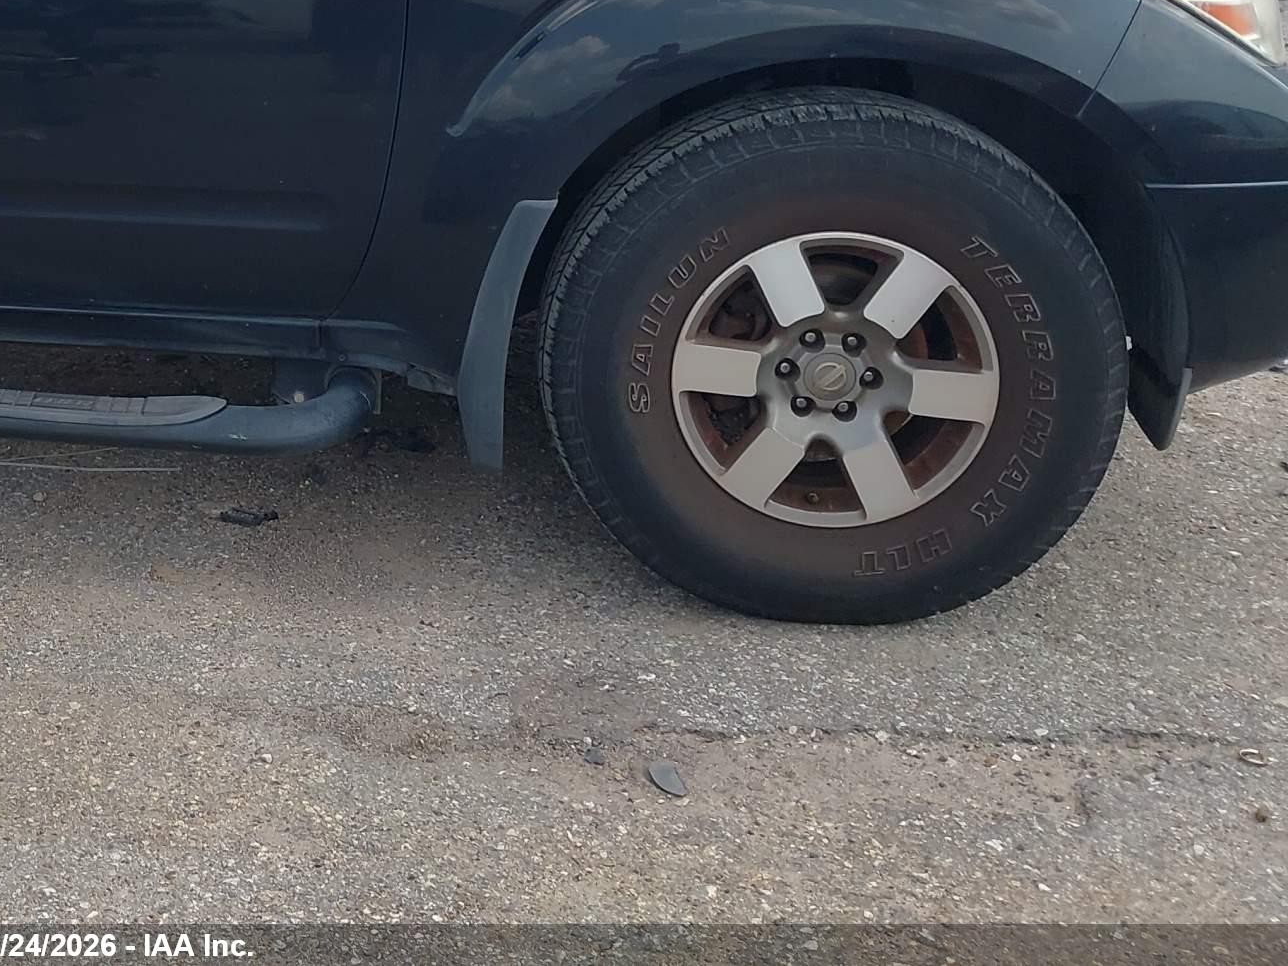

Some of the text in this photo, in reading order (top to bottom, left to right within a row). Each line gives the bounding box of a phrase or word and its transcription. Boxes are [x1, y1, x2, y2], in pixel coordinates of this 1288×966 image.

[627, 226, 732, 413] SAILUN
[854, 234, 1058, 576] TERRAMAX HLT
